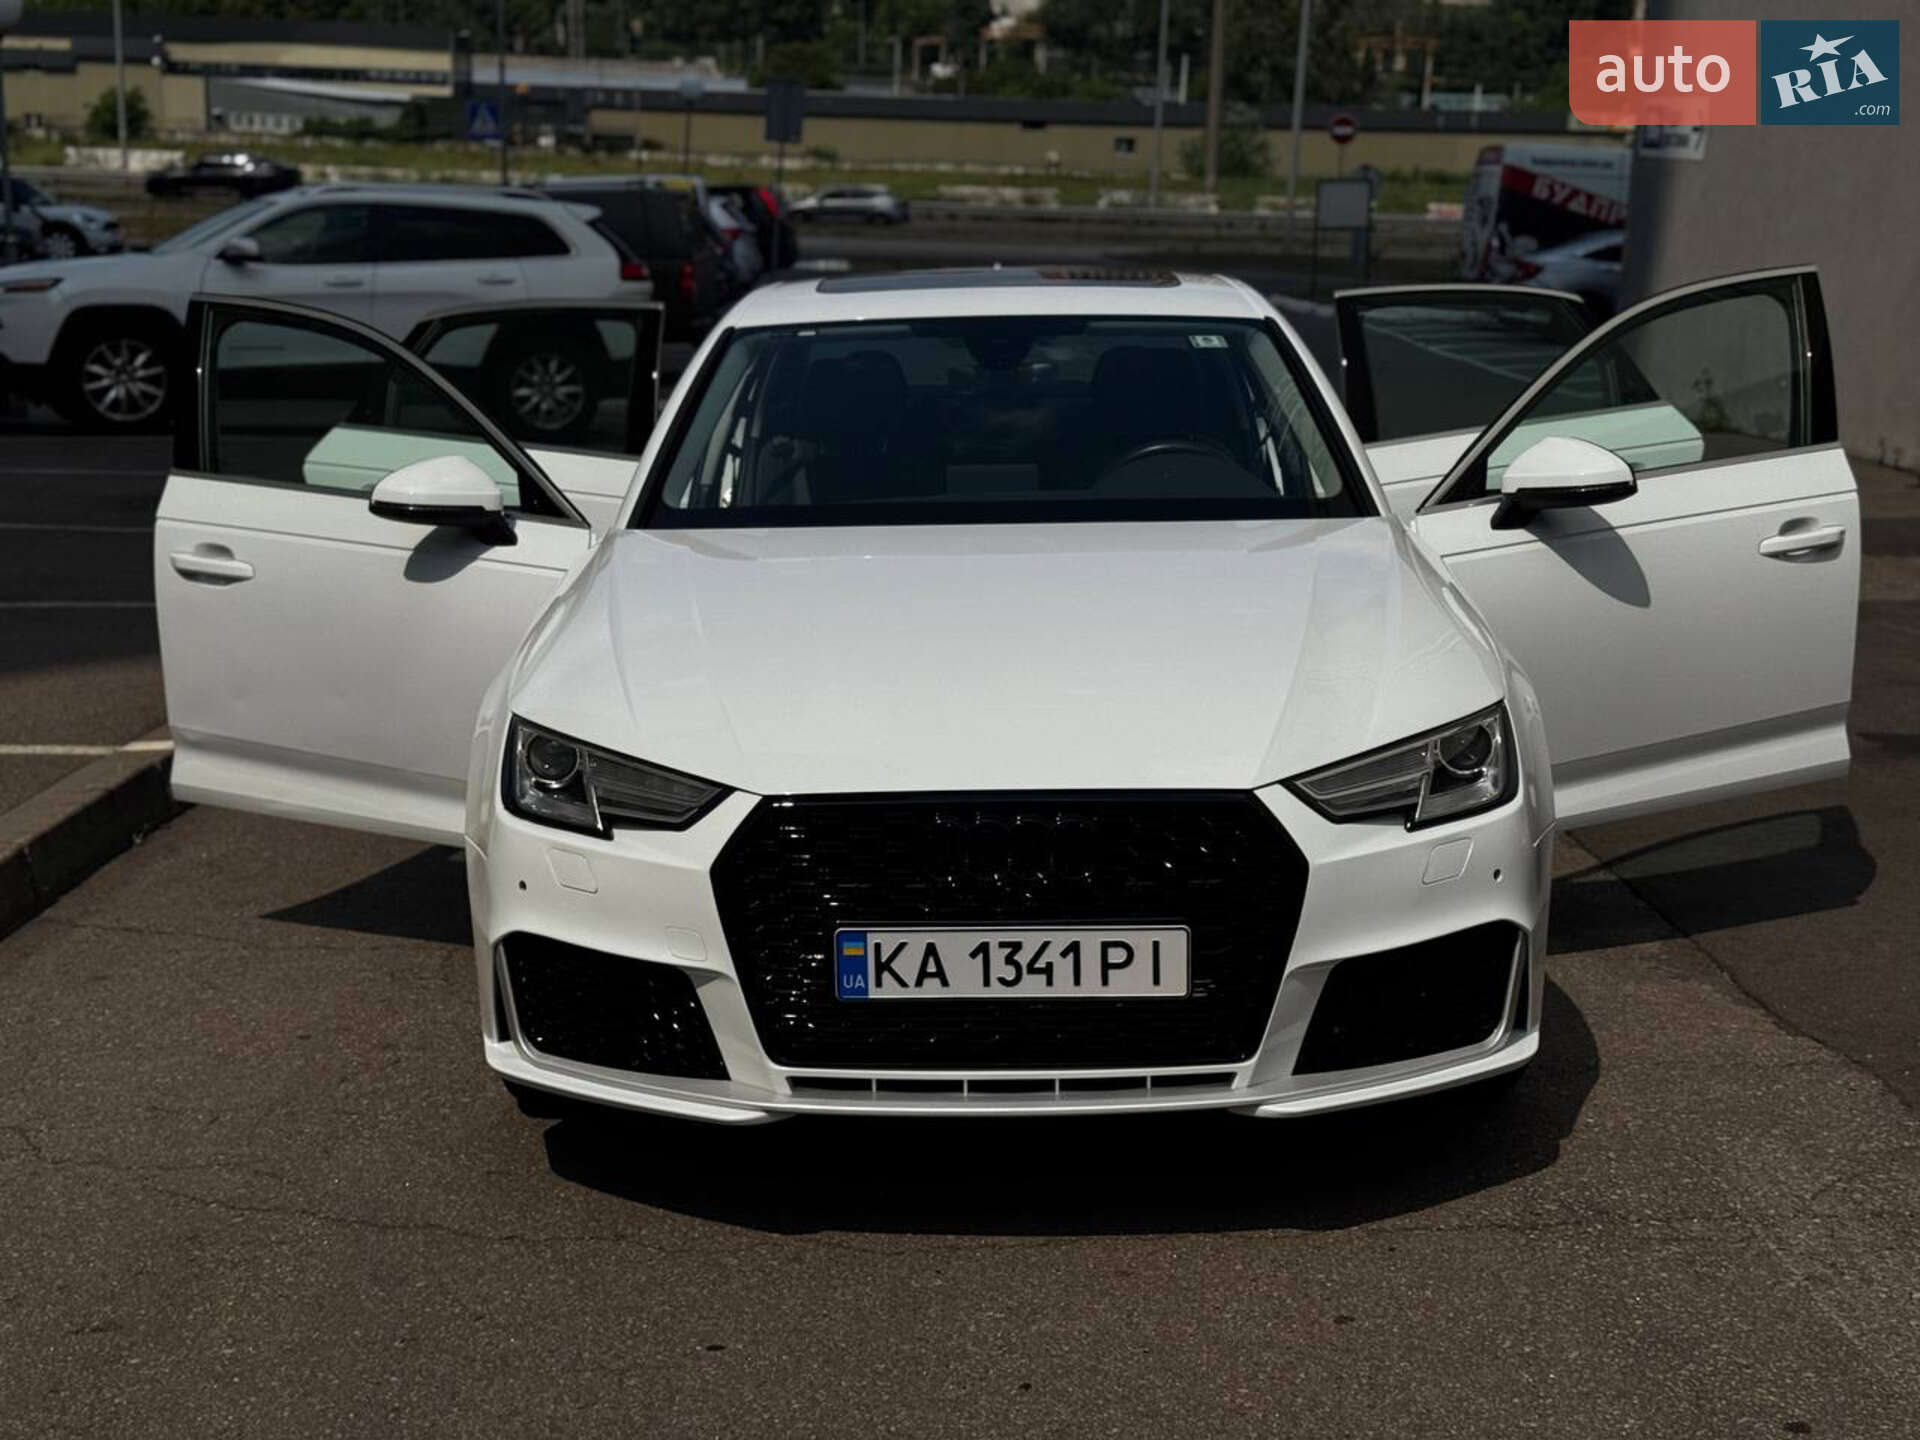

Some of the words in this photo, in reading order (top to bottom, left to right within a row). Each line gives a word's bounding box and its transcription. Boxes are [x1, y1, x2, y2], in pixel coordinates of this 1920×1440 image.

[873, 941, 950, 988] KA
[968, 940, 1082, 988] 1341
[1099, 940, 1161, 987] PI
[843, 975, 866, 989] UA
